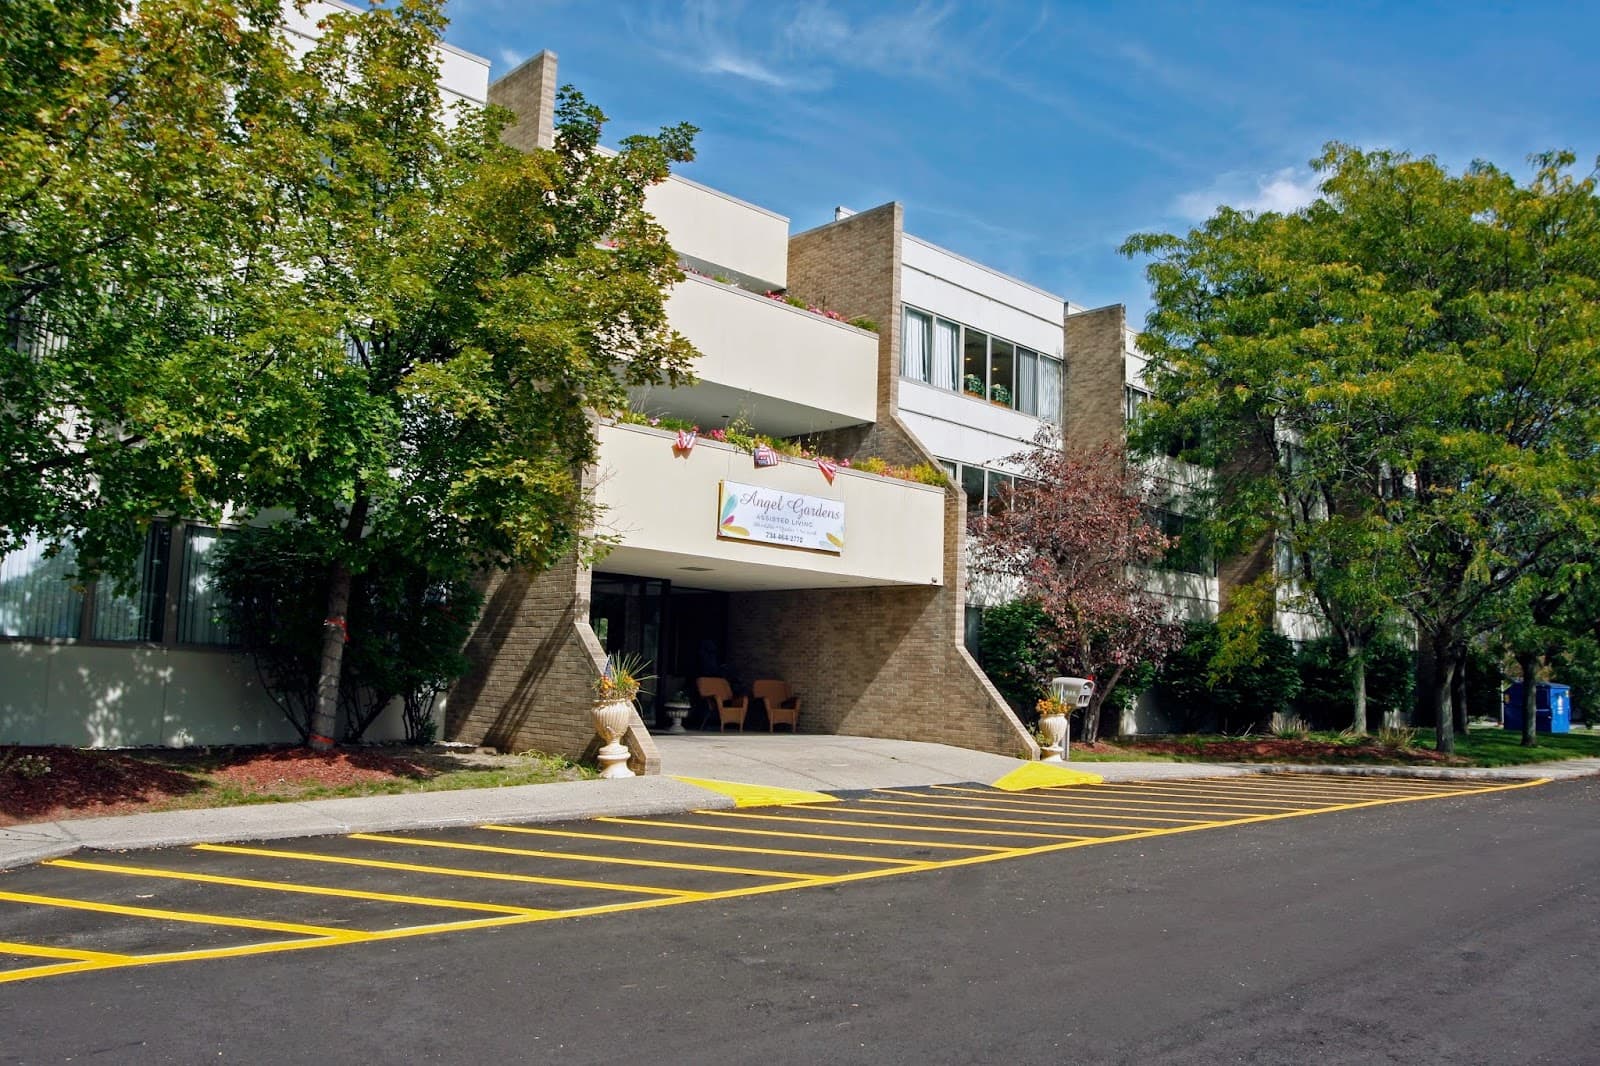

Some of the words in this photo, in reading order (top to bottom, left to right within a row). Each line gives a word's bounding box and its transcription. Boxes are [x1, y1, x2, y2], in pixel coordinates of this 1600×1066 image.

[740, 491, 784, 514] Angel
[787, 498, 840, 520] Gardens
[756, 515, 790, 525] ASSISTED
[792, 519, 813, 528] LIVING
